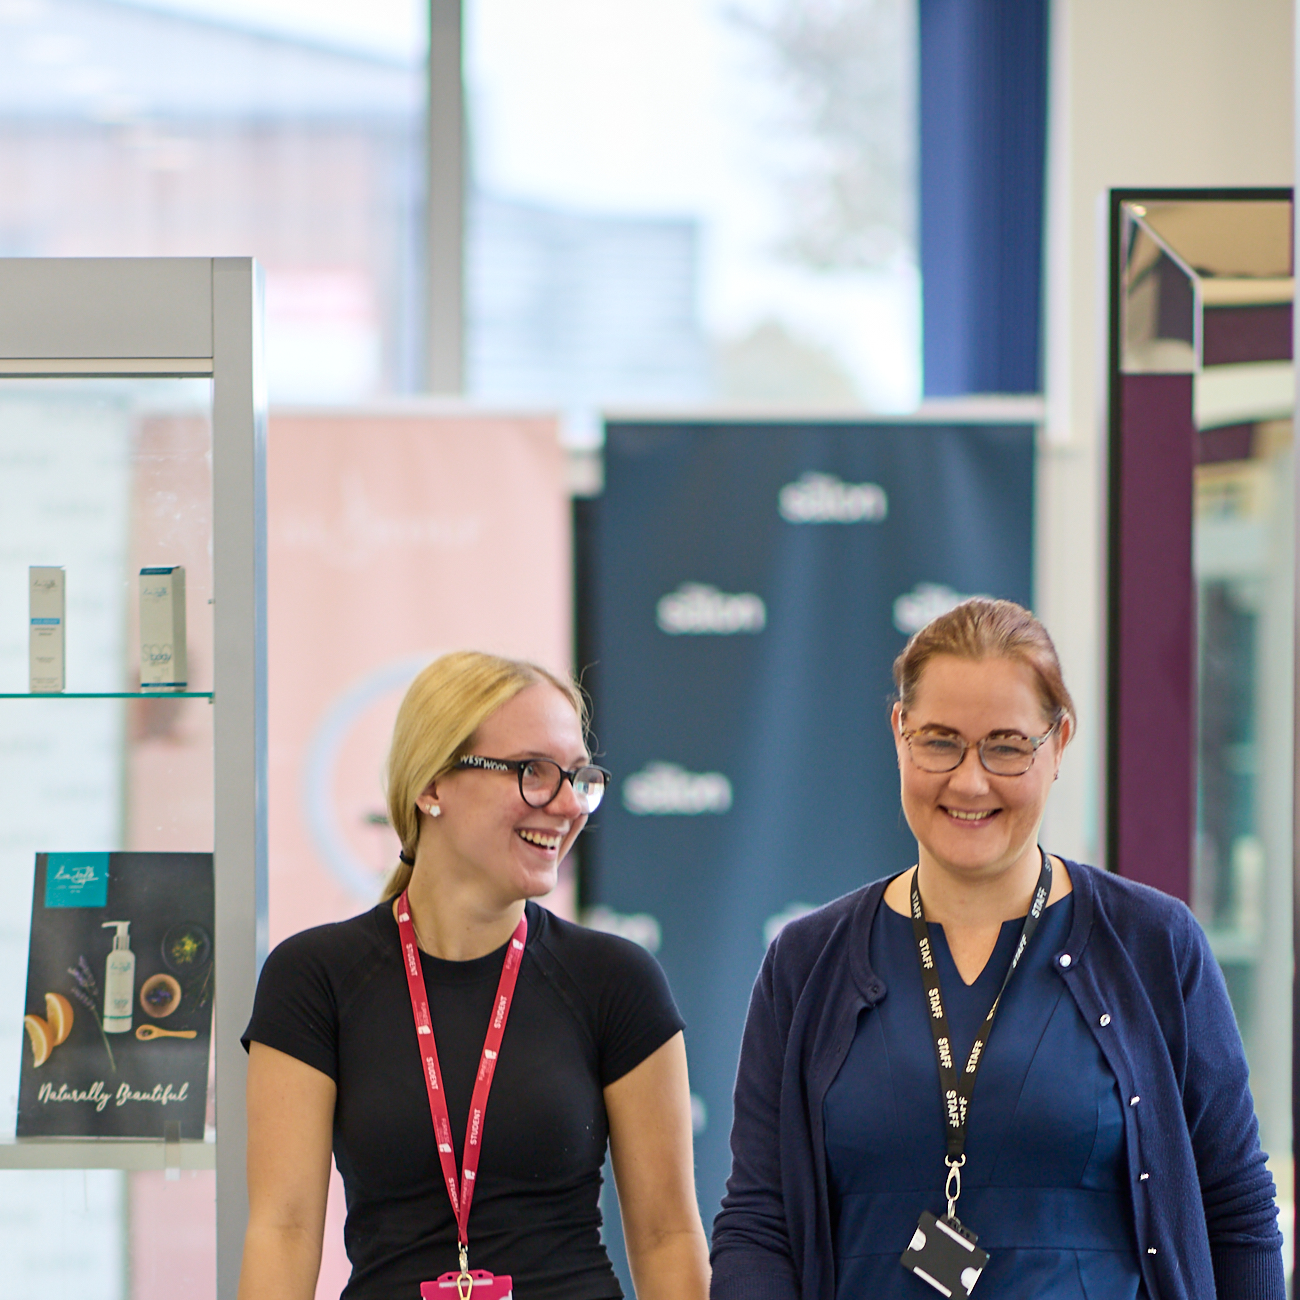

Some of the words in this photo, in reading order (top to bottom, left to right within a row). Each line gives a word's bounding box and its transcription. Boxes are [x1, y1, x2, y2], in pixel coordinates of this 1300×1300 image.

[911, 890, 922, 920] STAFF
[1031, 886, 1048, 919] STAFF
[406, 943, 418, 976] STUDENT
[919, 937, 934, 970] STAFF
[493, 995, 507, 1029] STUDENT
[928, 987, 943, 1019] STAFF
[937, 1037, 953, 1069] STAFF
[965, 1040, 983, 1073] STAFF
[426, 1056, 439, 1090] STUDENT
[38, 1081, 112, 1112] Naturally
[116, 1081, 189, 1106] Beautiful
[945, 1089, 960, 1128] STAFF
[470, 1108, 482, 1145] STUDENT
